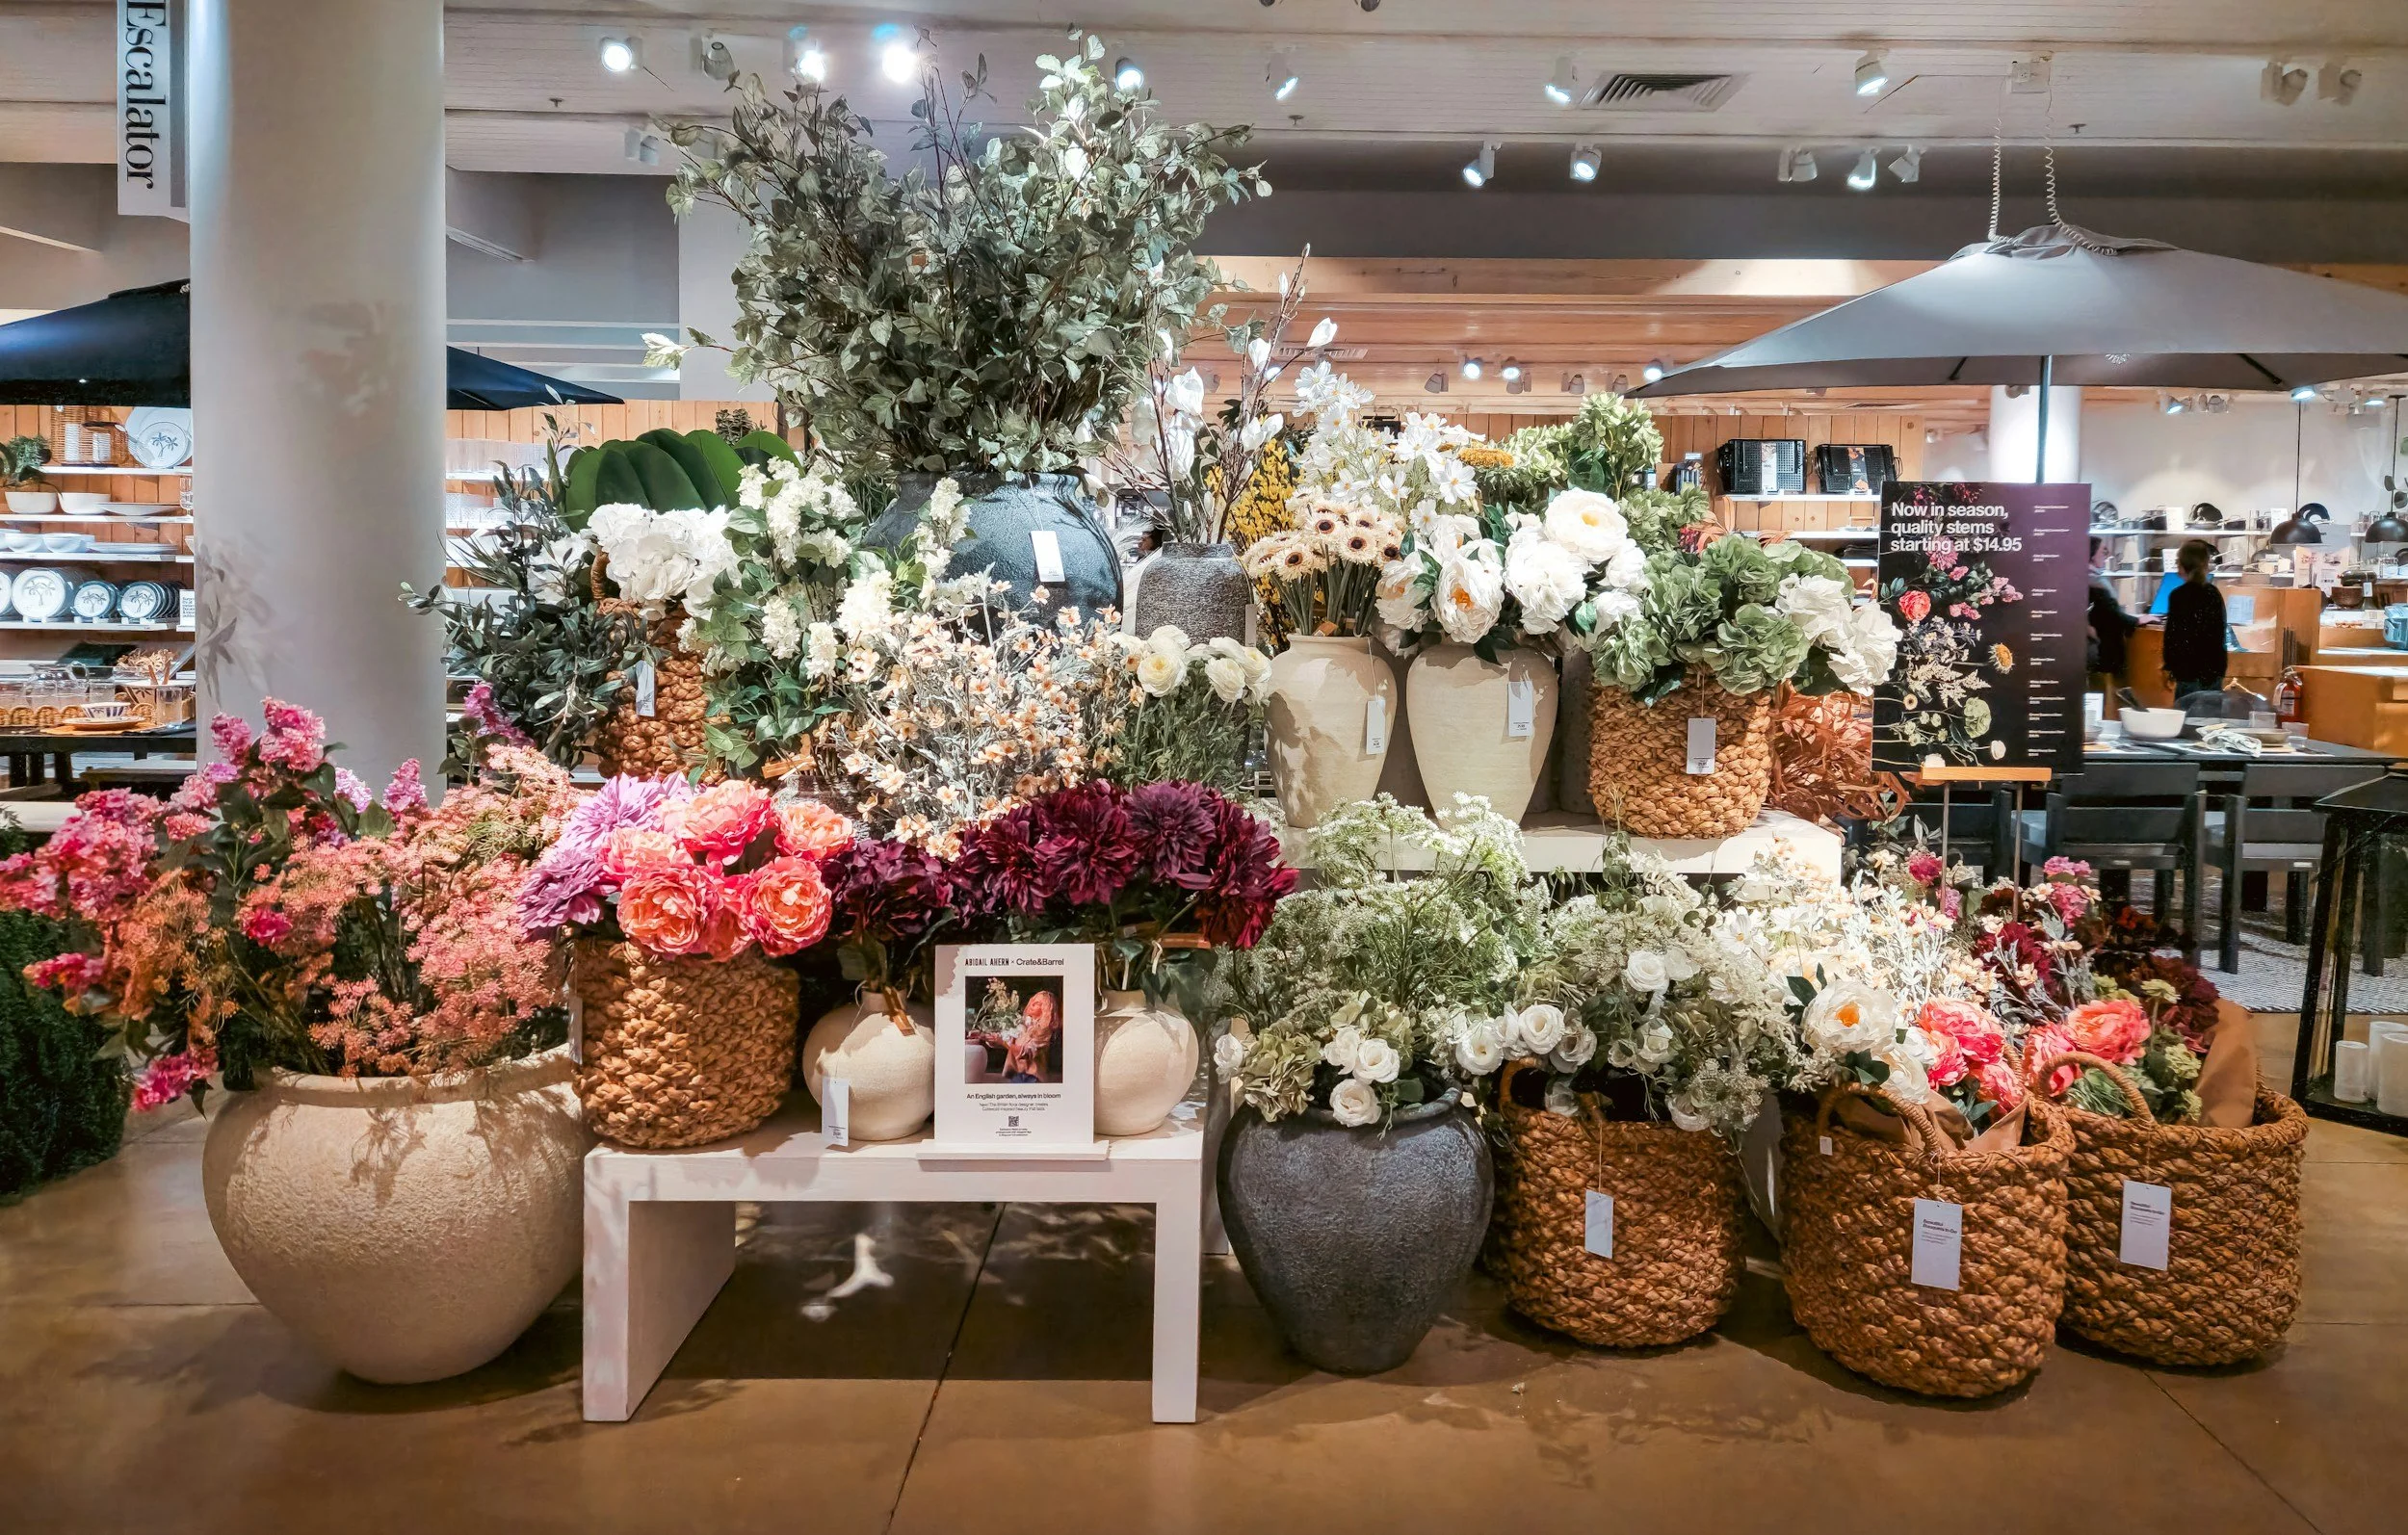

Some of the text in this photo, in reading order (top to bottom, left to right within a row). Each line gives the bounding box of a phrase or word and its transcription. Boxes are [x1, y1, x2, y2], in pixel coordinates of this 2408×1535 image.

[125, 0, 167, 190] Escalator
[1892, 502, 2009, 520] Now in season,
[1891, 520, 1995, 536] quality stems
[1890, 536, 2023, 555] starting at $14.95
